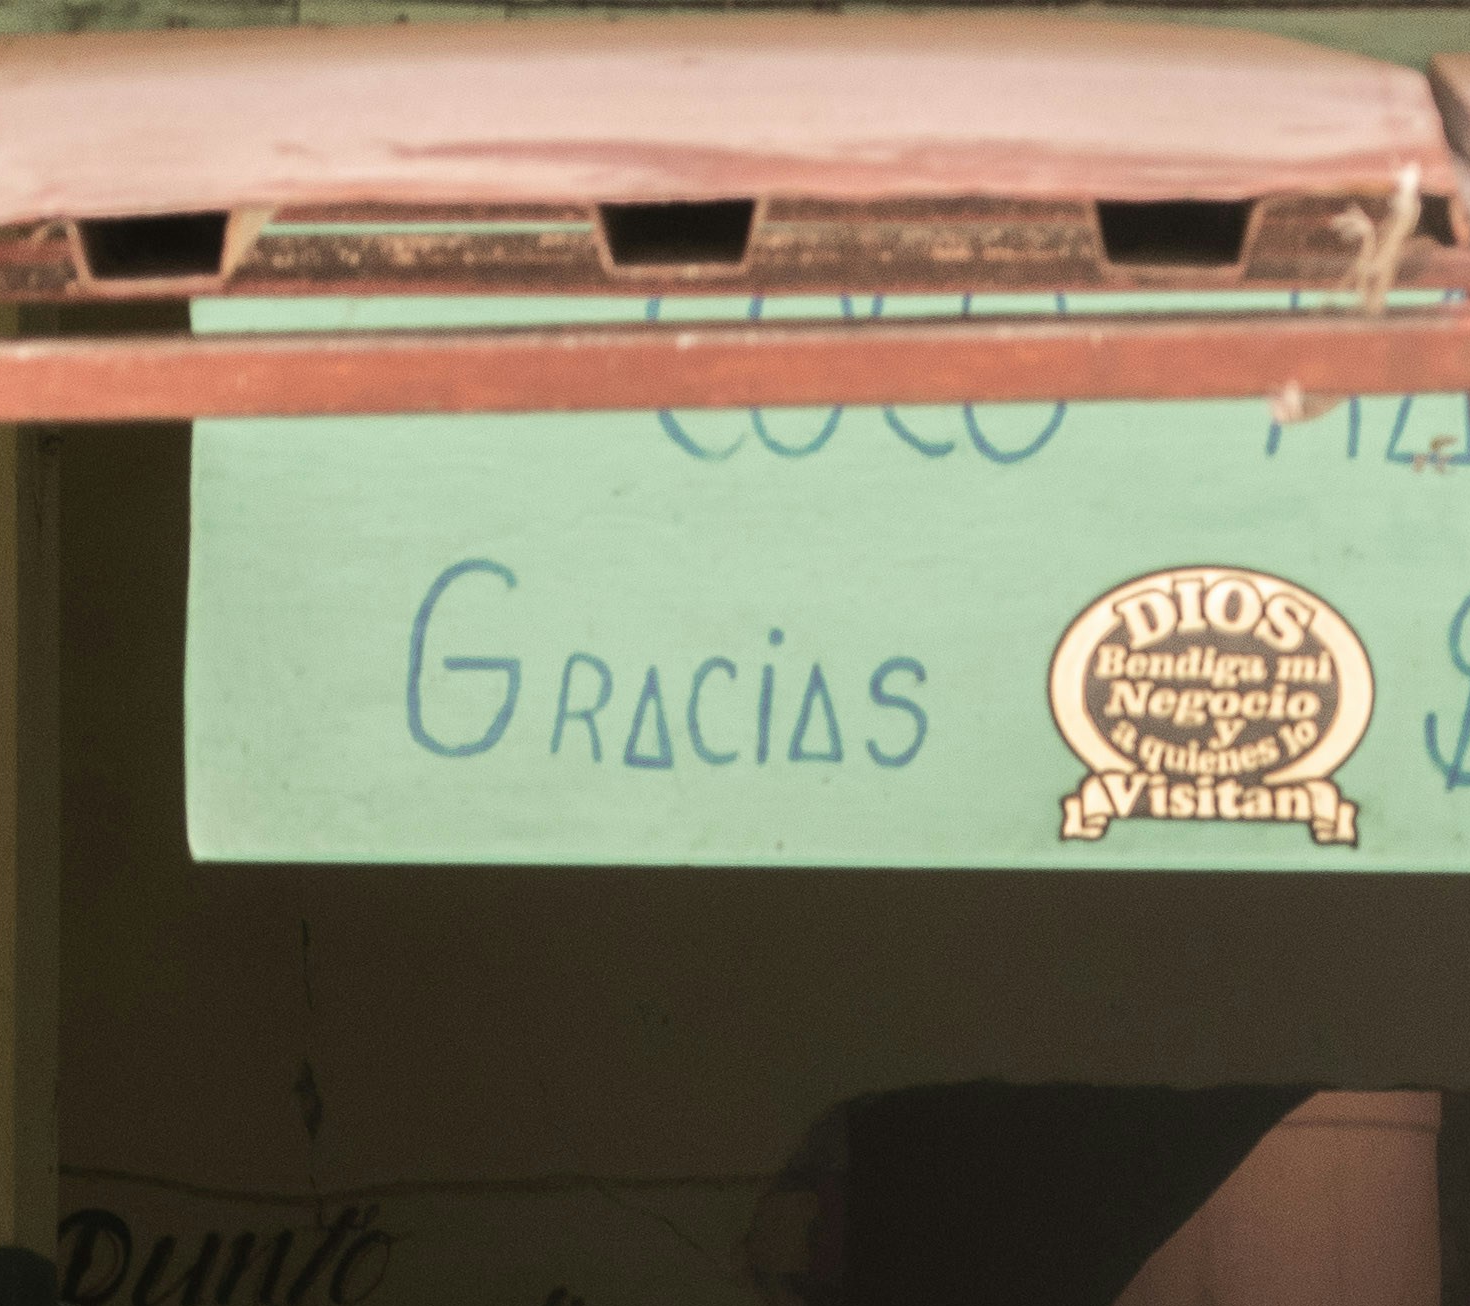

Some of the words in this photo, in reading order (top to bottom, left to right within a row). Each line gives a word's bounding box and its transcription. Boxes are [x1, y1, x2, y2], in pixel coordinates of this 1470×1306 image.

[1114, 576, 1317, 650] DIOS
[1096, 644, 1268, 687] Bendiga
[1275, 649, 1334, 683] mi
[1105, 680, 1323, 728] Negocio
[1110, 720, 1139, 753] a
[1138, 733, 1281, 776] quienes
[1100, 771, 1314, 820] Visitan
